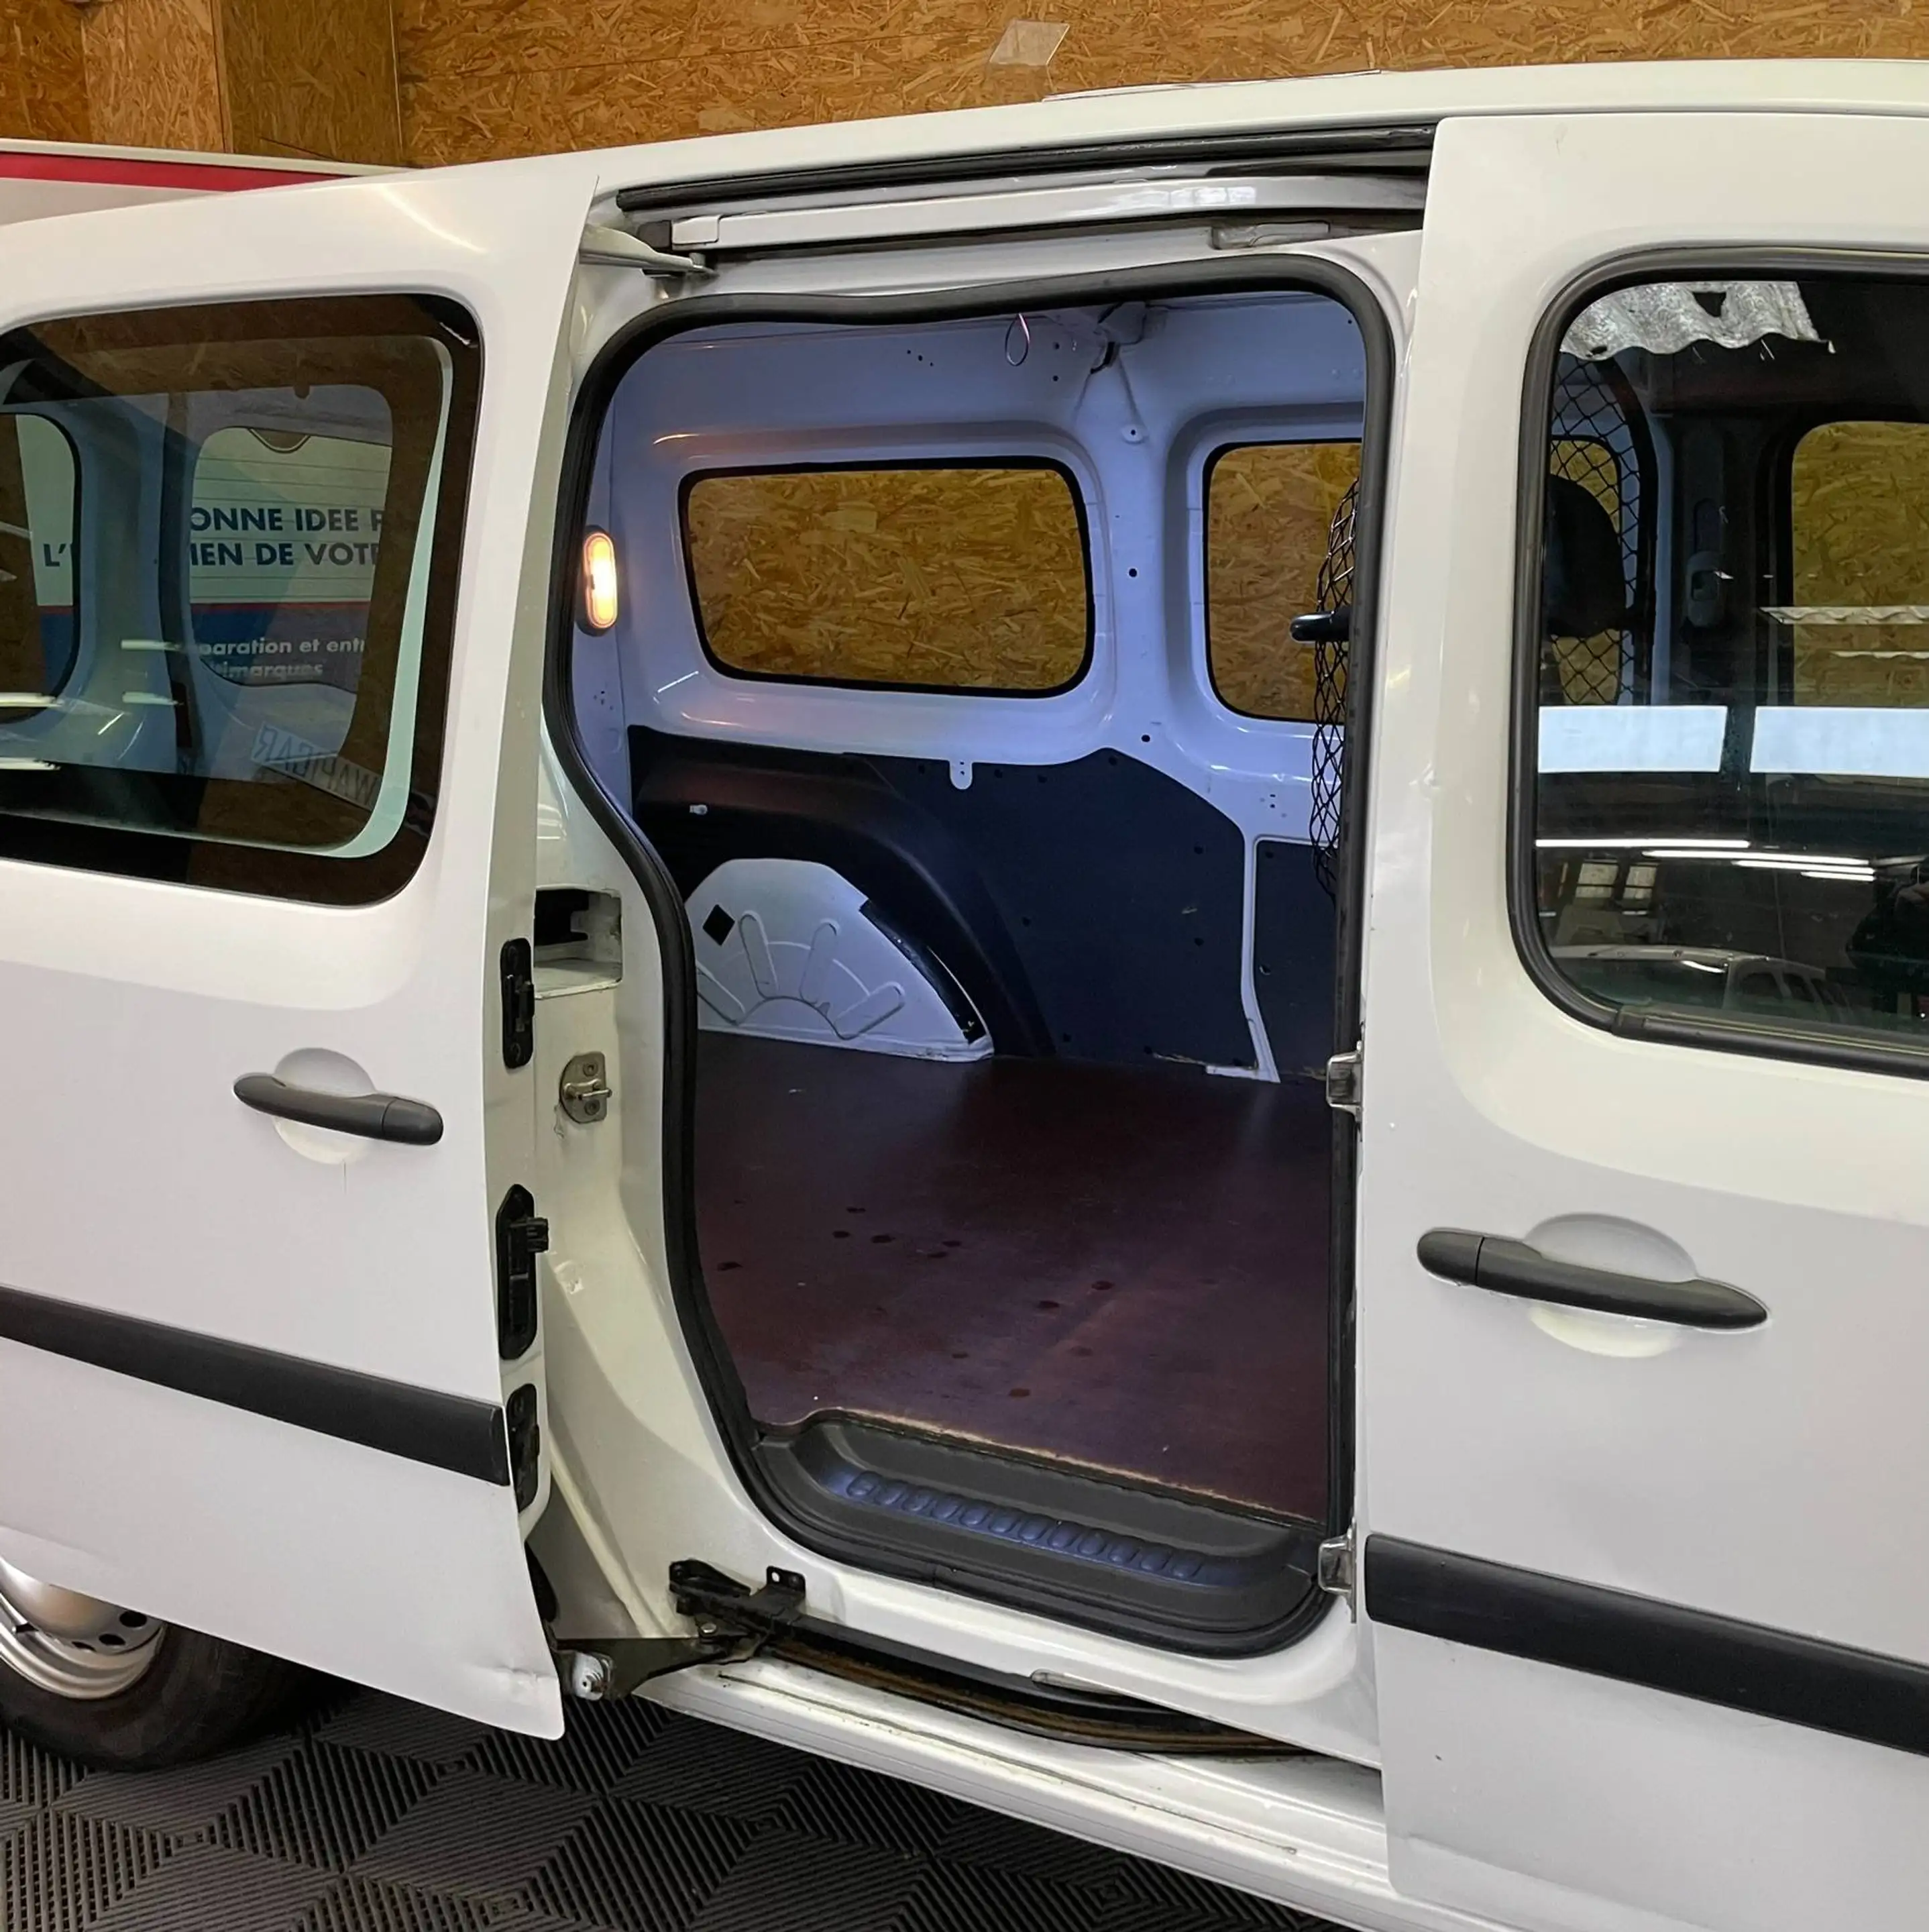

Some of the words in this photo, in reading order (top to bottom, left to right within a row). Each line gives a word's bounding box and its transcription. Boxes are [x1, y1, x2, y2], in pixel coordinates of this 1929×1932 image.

[295, 508, 359, 531] IDEE
[256, 543, 294, 566] DE
[299, 639, 320, 653] et
